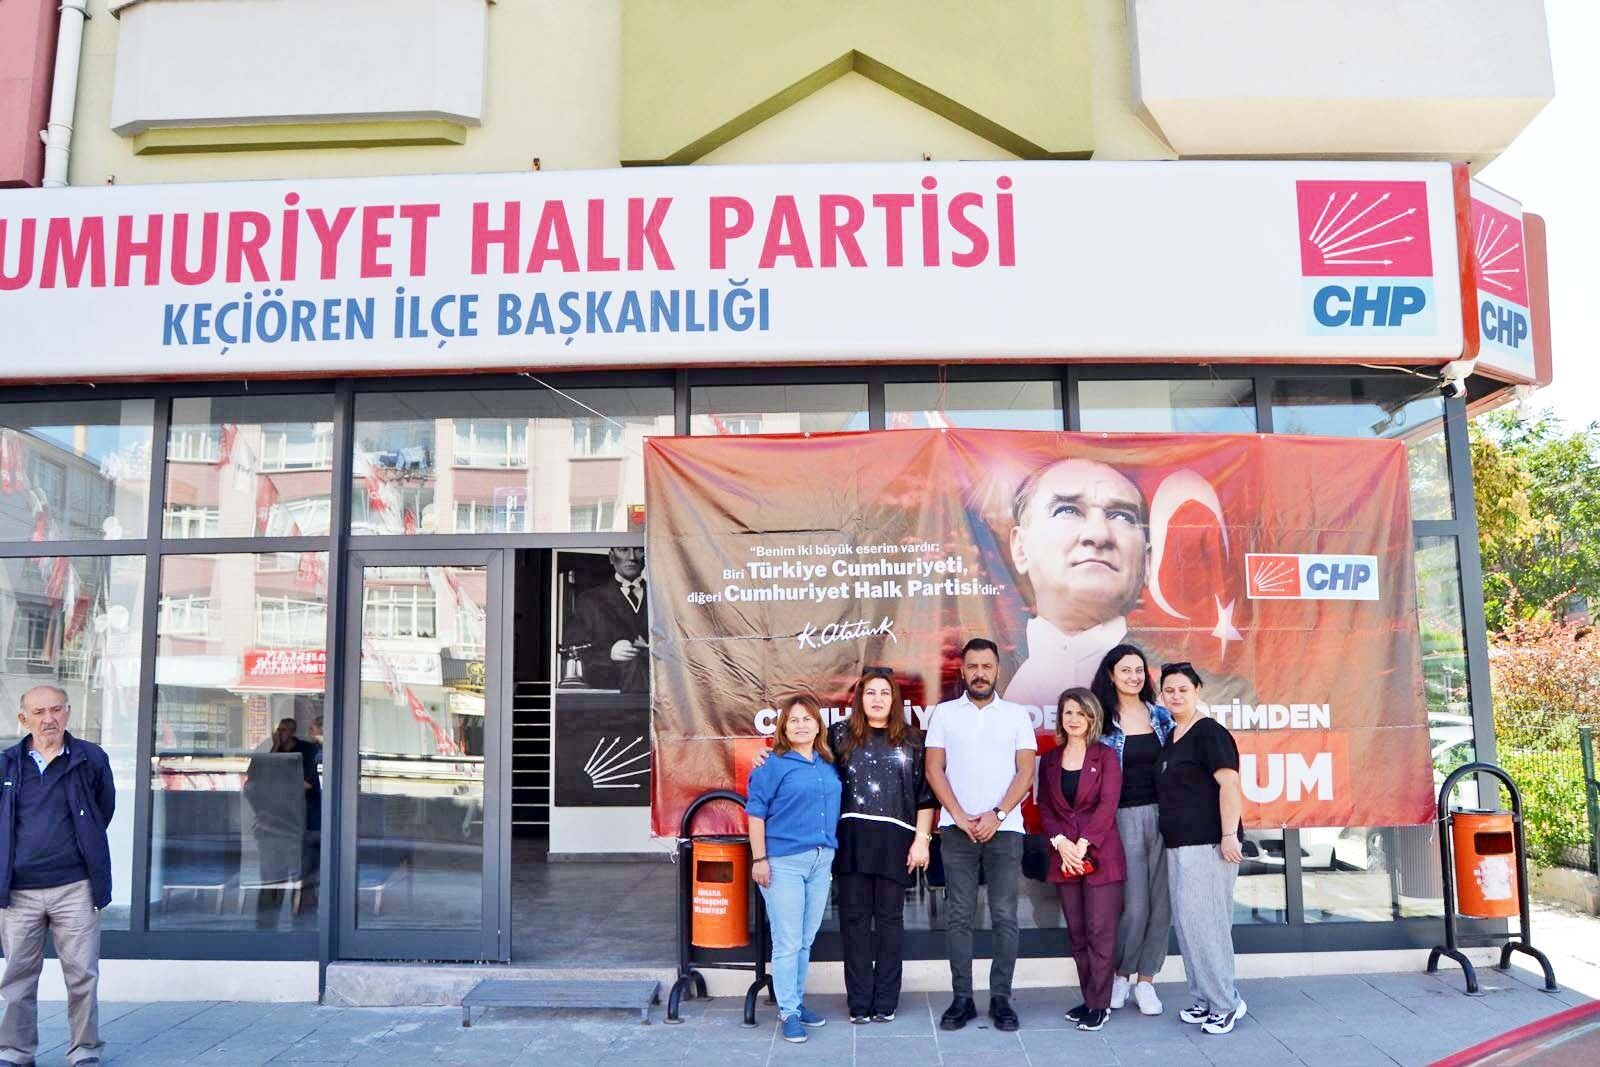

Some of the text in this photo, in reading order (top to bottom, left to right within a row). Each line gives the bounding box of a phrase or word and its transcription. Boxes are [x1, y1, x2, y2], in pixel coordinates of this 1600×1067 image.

[0, 176, 1016, 291] UMHURİYET HALK PARTİSİ
[162, 278, 770, 355] KEÇİÖREN İLÇE BAŞKANLIĞI
[1313, 285, 1426, 327] CHP
[1480, 300, 1527, 349] CHP
[750, 541, 940, 557] “Benim iki büyük eserim vardır:
[722, 556, 968, 581] Biri Türkiye Cumhuriyeti,
[1306, 562, 1371, 591] CHP
[686, 591, 722, 605] diğeri
[724, 582, 850, 603] Cumhuriyet
[854, 580, 904, 599] Halk
[1195, 697, 1331, 729] TİMDEN
